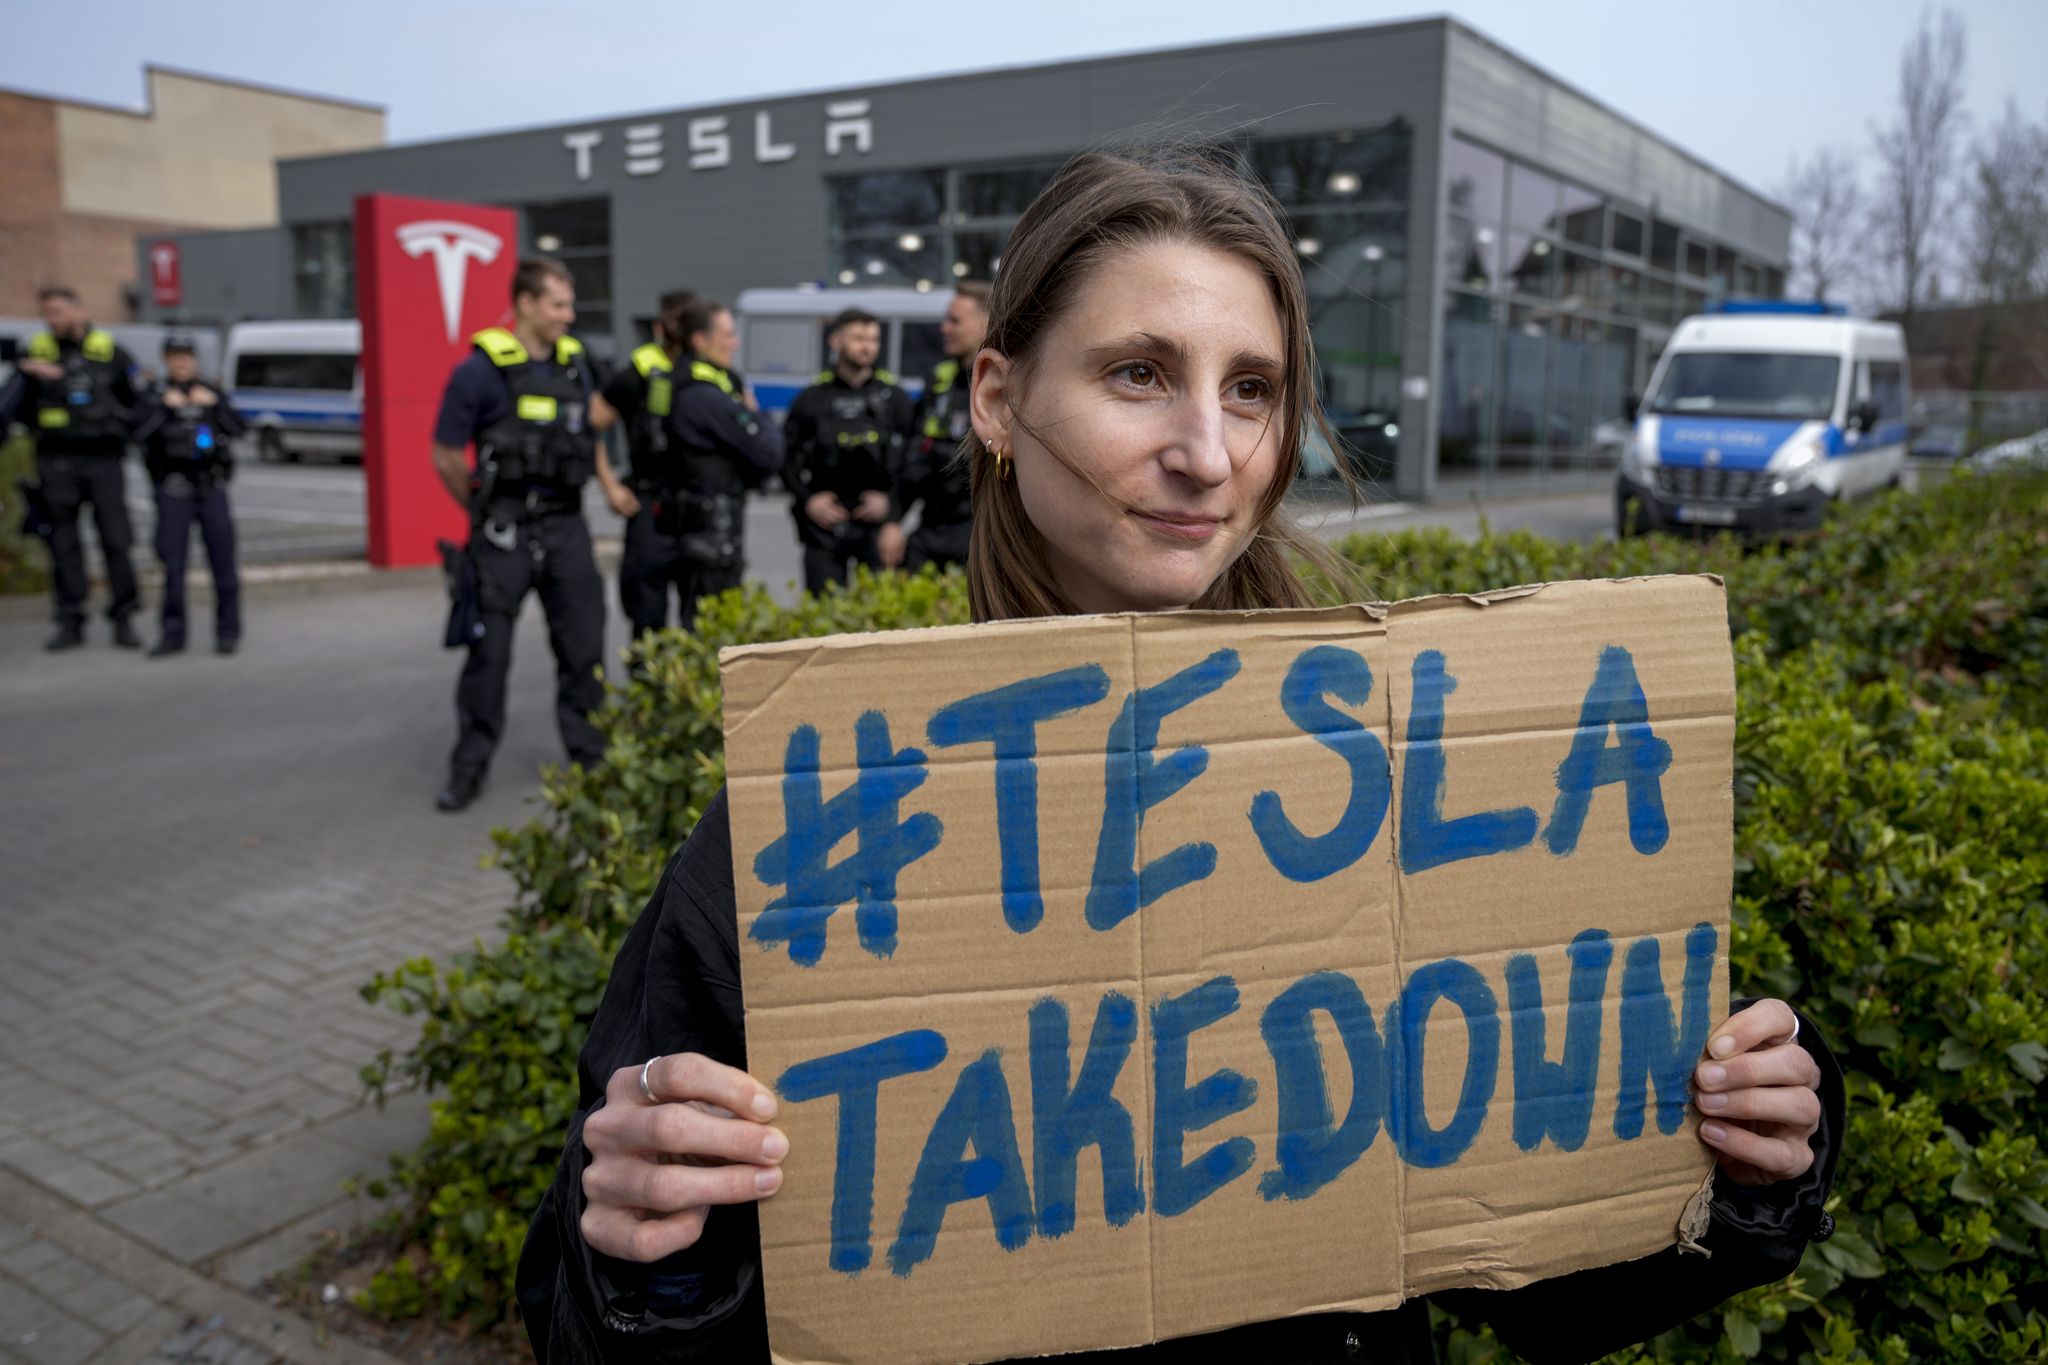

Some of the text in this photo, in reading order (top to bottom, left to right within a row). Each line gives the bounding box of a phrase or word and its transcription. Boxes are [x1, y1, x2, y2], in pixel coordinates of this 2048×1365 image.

[562, 99, 872, 181] TESLA
[748, 644, 1674, 968] #TESLA
[774, 922, 1718, 1279] TAKEDOWN
